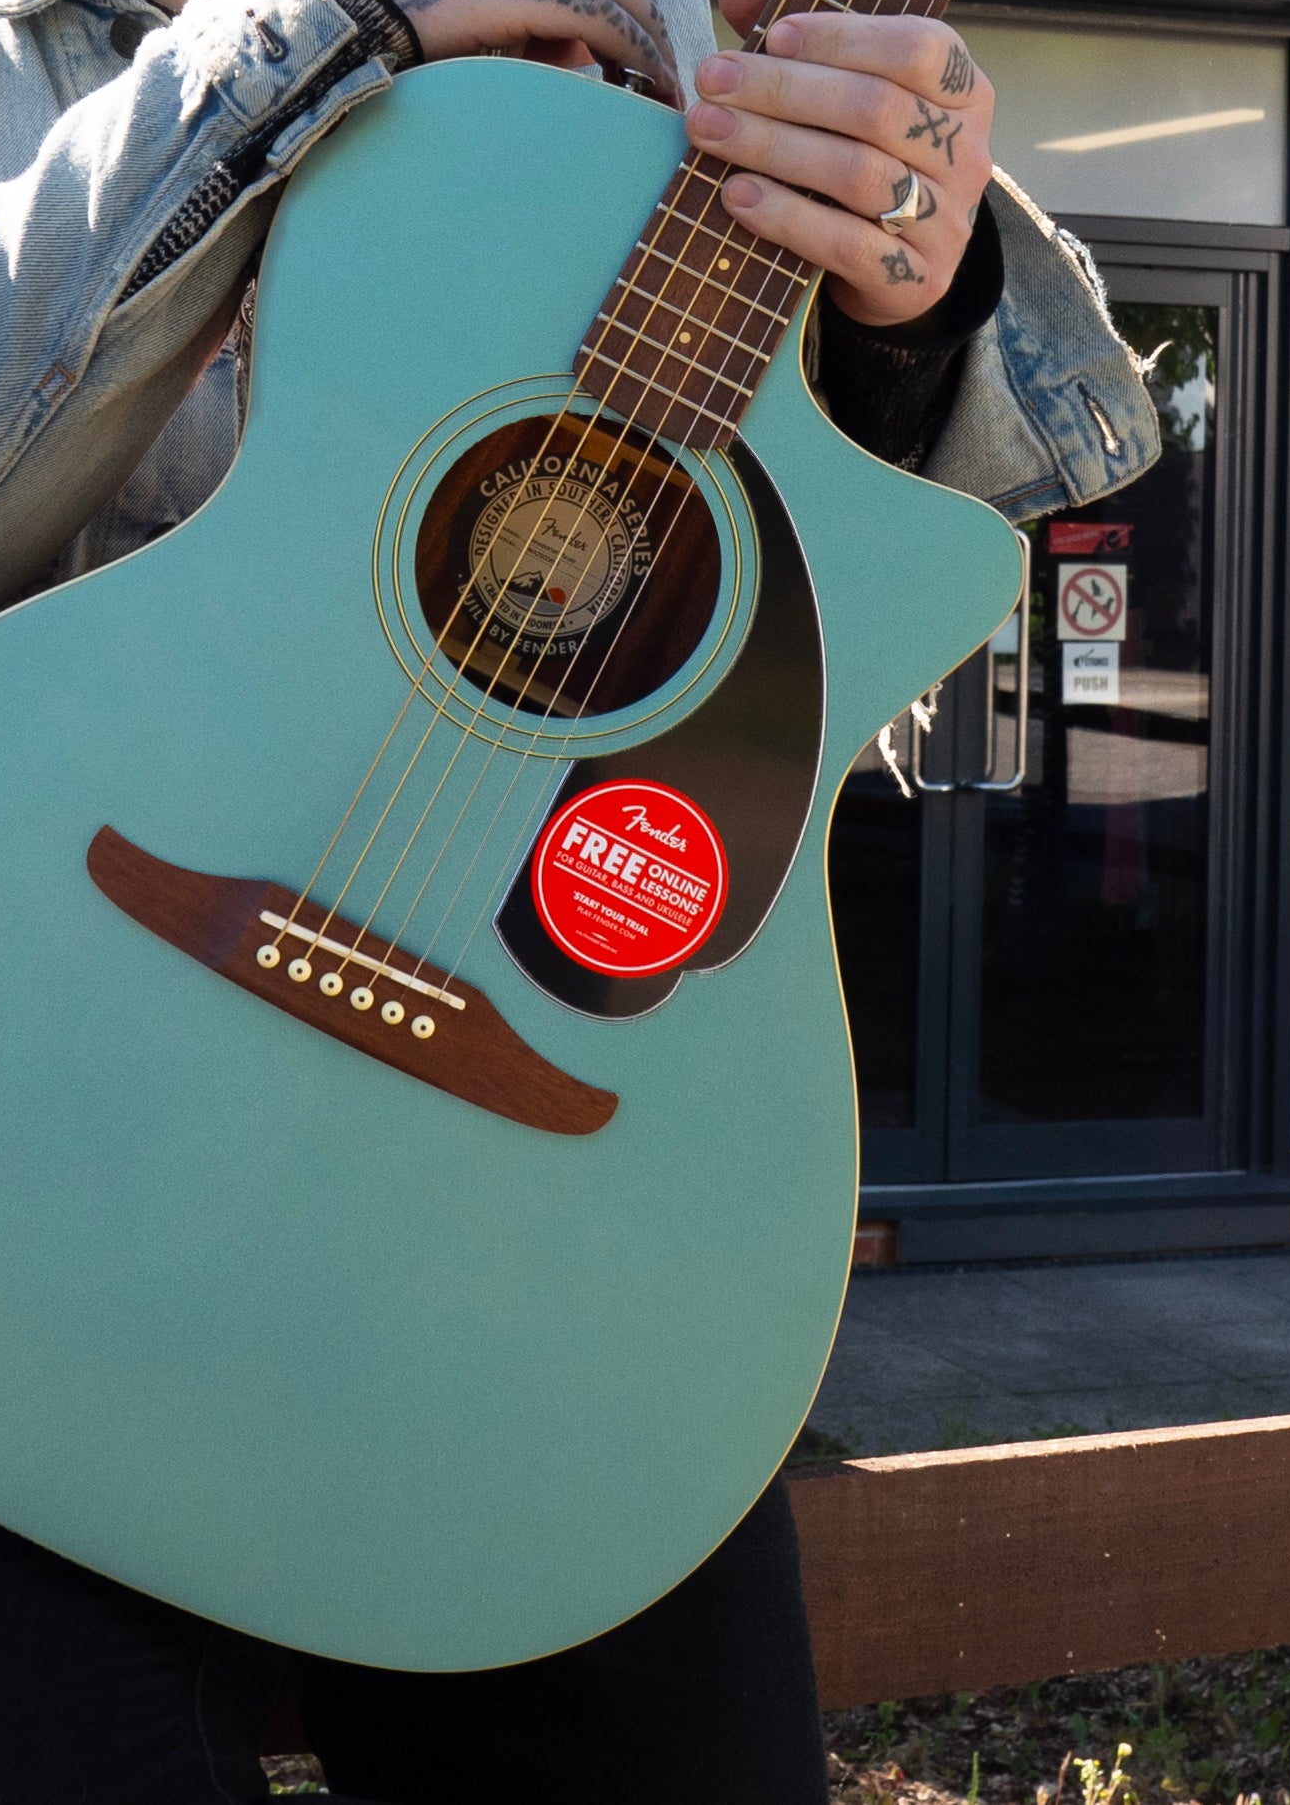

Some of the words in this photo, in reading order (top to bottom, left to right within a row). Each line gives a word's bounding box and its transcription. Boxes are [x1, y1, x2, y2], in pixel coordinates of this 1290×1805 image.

[474, 492, 522, 556] DESIGNED
[525, 482, 543, 498] IN
[549, 482, 617, 528] SOUTHERN
[542, 517, 589, 552] Fender
[620, 498, 652, 576] SERIES
[488, 625, 511, 643] BY
[513, 637, 578, 655] FENDER
[1073, 676, 1109, 692] PUSH
[621, 805, 688, 853] Fender
[561, 821, 647, 885] FREE
[647, 863, 708, 903] ONLINE
[555, 851, 574, 866] FOR
[575, 861, 609, 886] GUITAR,
[611, 878, 634, 897] BASS
[635, 890, 656, 908] AND
[657, 901, 694, 927] UKULELE
[599, 903, 626, 924] YOUR
[625, 916, 650, 937] TRIAL
